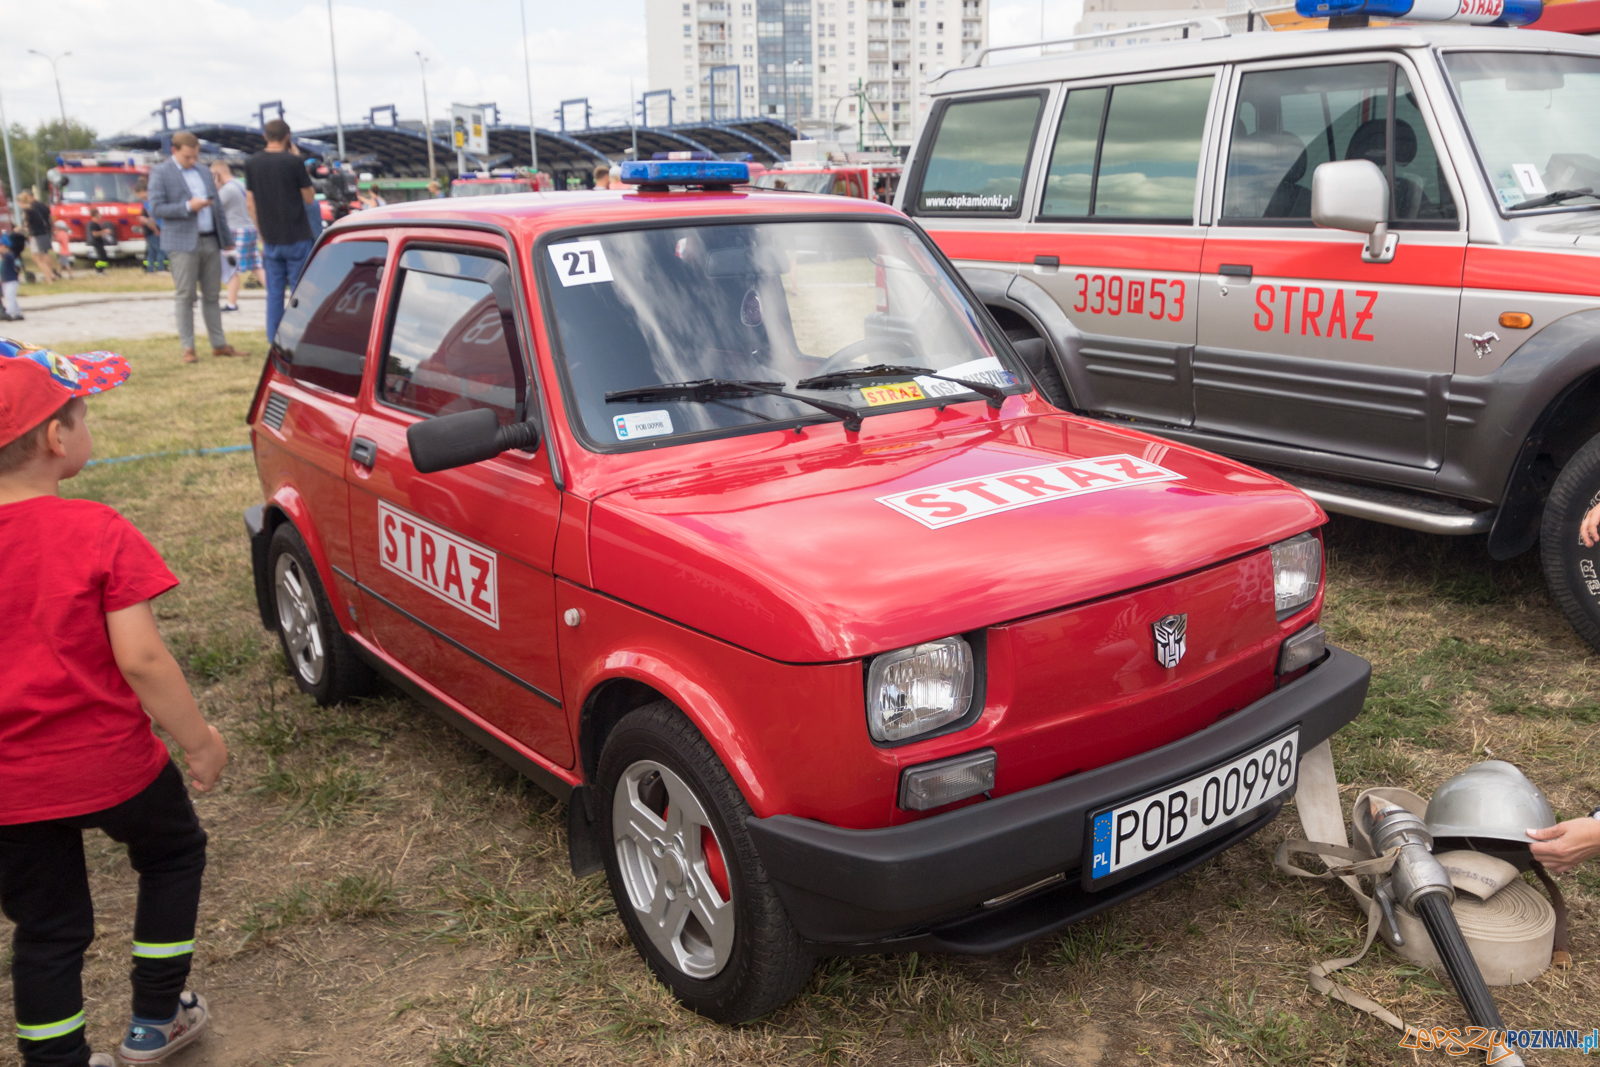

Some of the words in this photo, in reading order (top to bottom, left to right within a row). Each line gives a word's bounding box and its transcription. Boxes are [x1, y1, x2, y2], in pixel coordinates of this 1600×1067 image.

[925, 194, 1013, 210] www.ospkamionki.pl
[562, 250, 597, 276] 27
[1114, 790, 1188, 866] POB
[1201, 740, 1294, 826] 00998
[1093, 852, 1108, 869] PL
